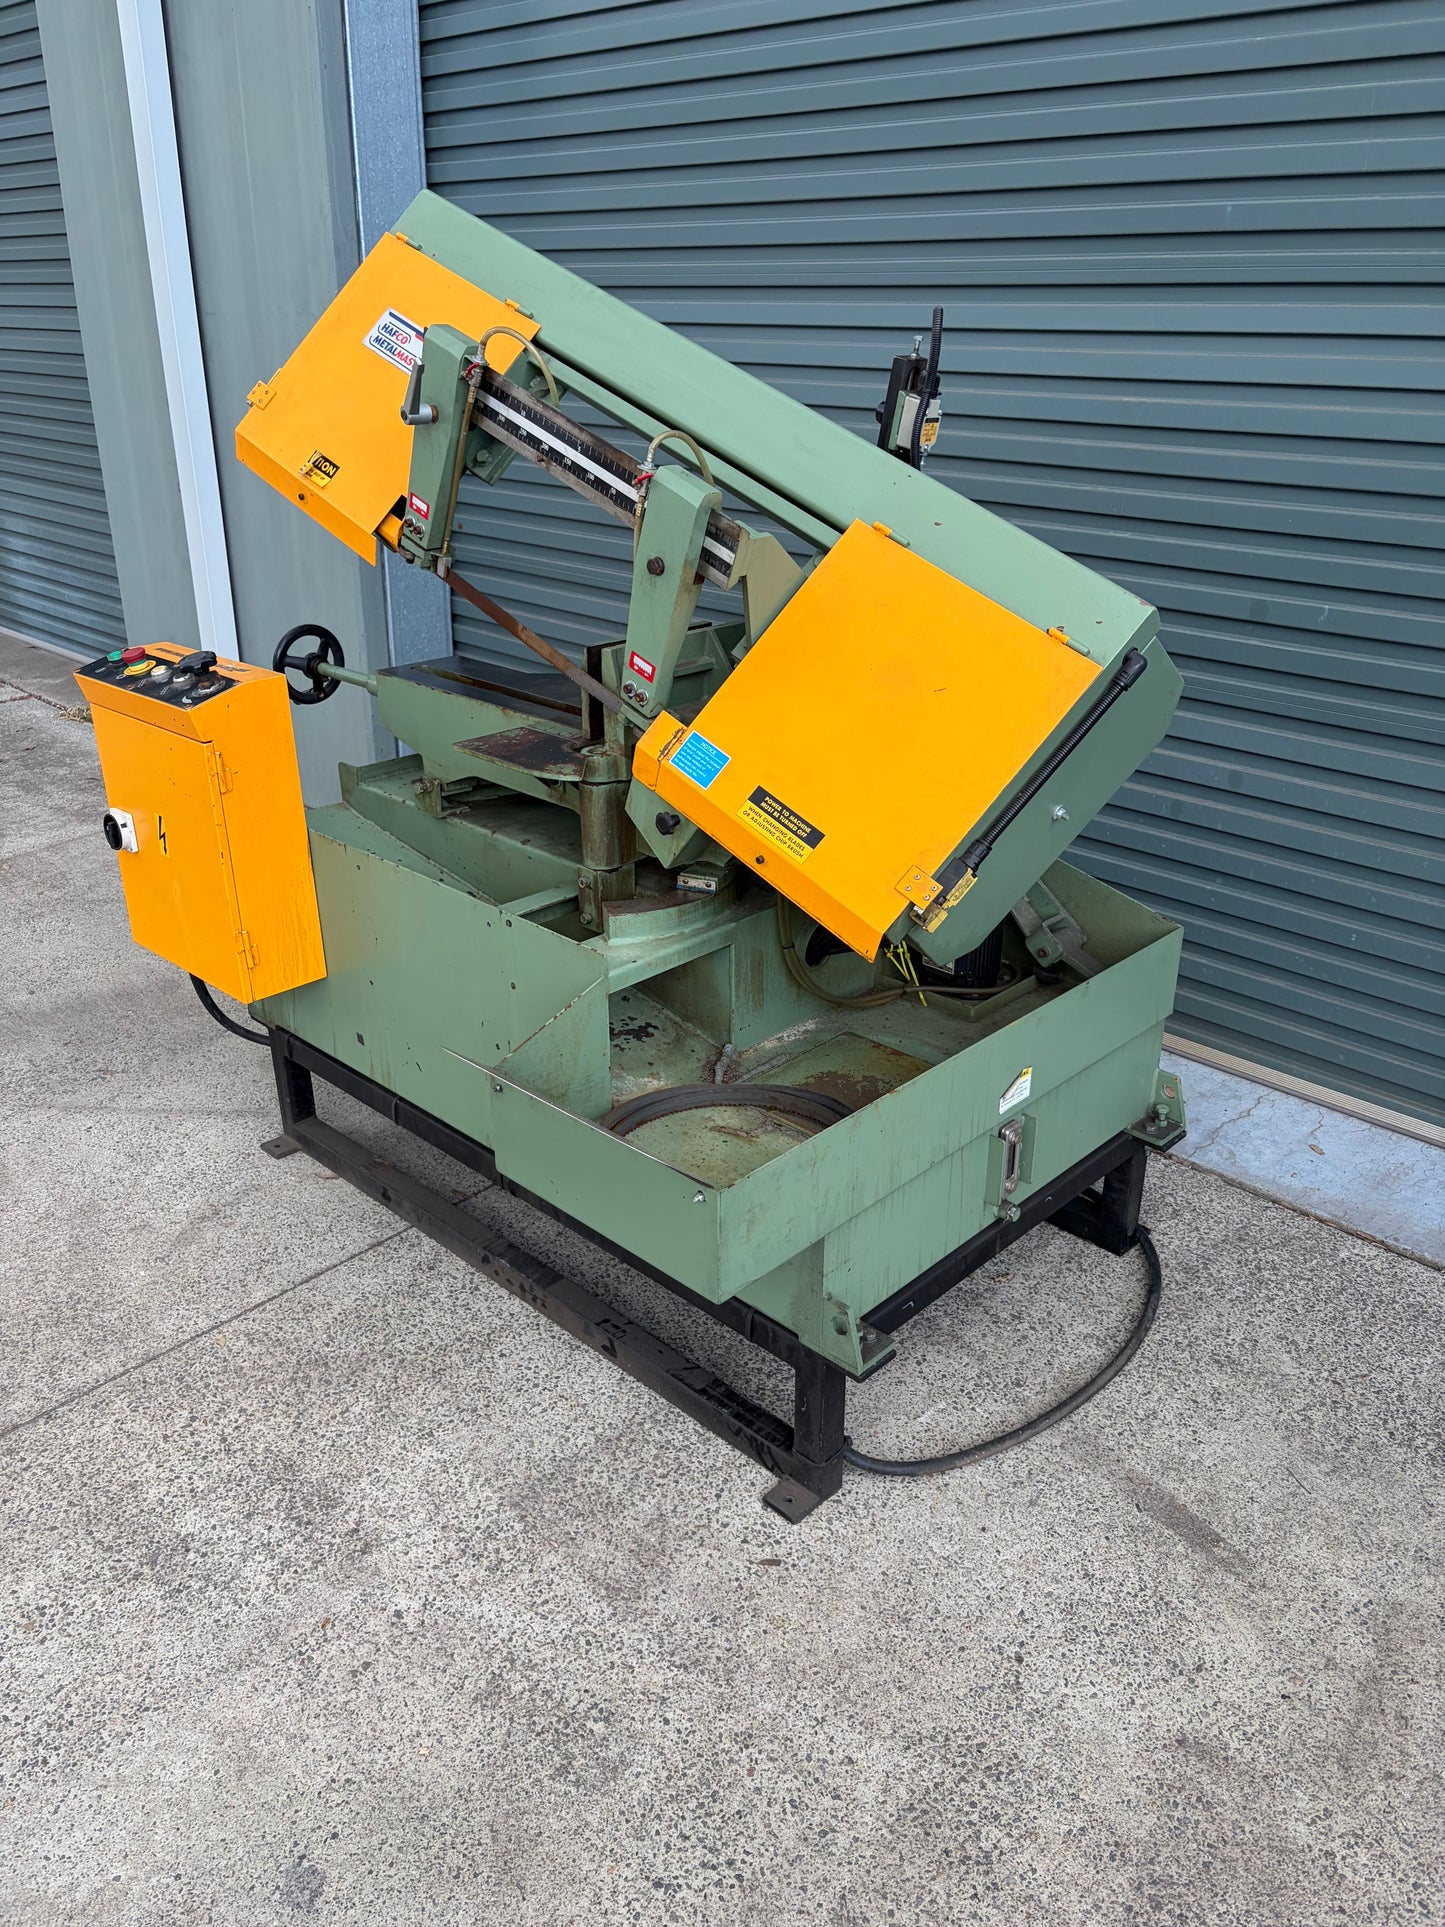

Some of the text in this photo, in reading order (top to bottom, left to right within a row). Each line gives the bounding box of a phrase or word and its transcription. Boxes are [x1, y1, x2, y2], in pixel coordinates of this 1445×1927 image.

[381, 323, 409, 345] HAFCO
[701, 742, 717, 756] NOTICE
[748, 806, 805, 851] WHEN CHANGING BLADES
[760, 802, 774, 813] MUST
[780, 816, 798, 831] TURNED
[797, 830, 808, 838] OFF
[764, 796, 782, 811] POWER
[789, 816, 812, 834] MACHINE
[750, 816, 775, 837] ADJUSTING
[776, 836, 787, 845] CHIP
[787, 845, 803, 858] BRUSH
